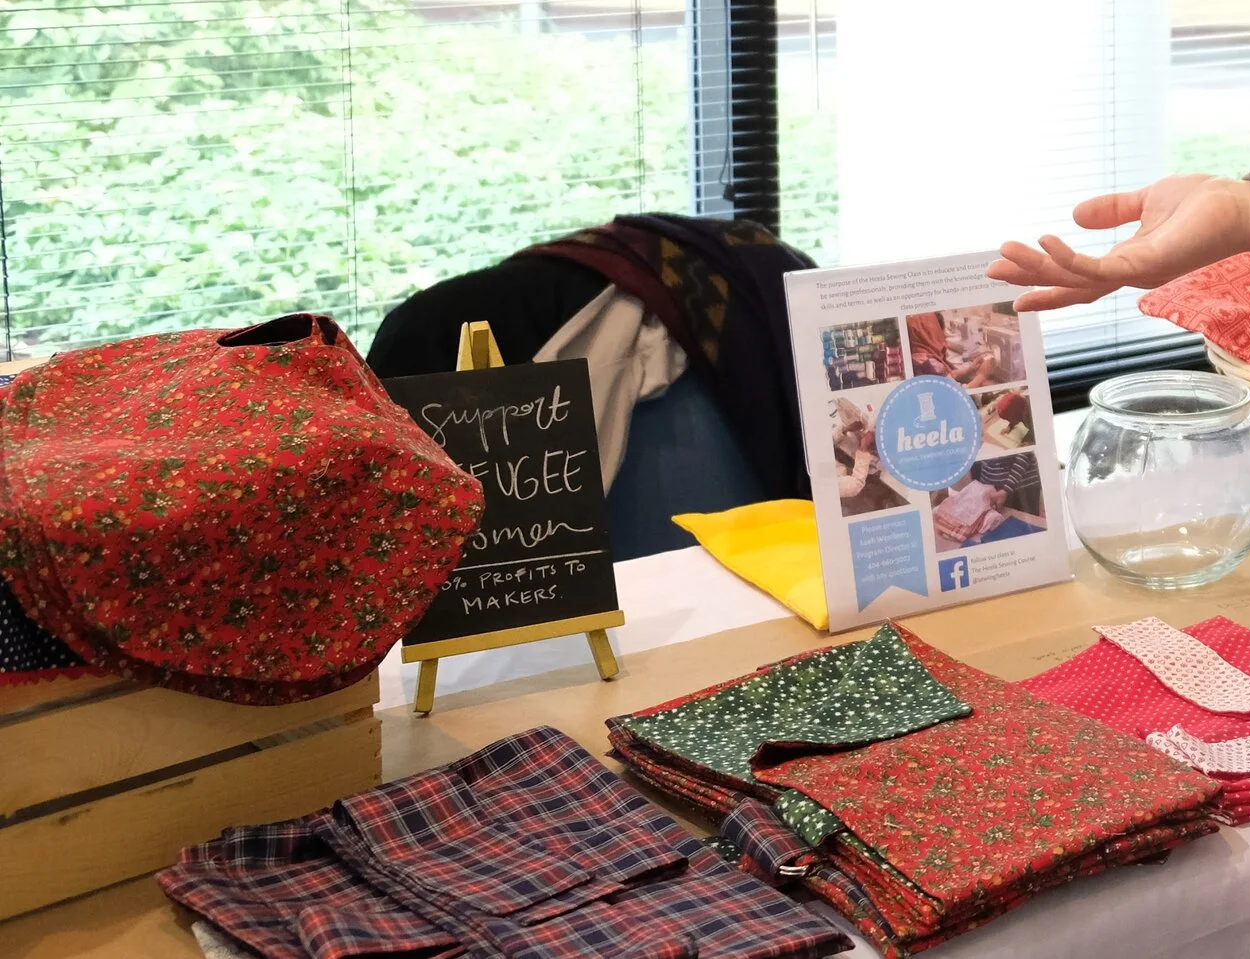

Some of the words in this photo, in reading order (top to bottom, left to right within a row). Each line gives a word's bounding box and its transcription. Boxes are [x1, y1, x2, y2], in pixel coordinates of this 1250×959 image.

[896, 419, 965, 453] heela
[456, 450, 588, 501] FUGEE
[472, 520, 594, 551] omen
